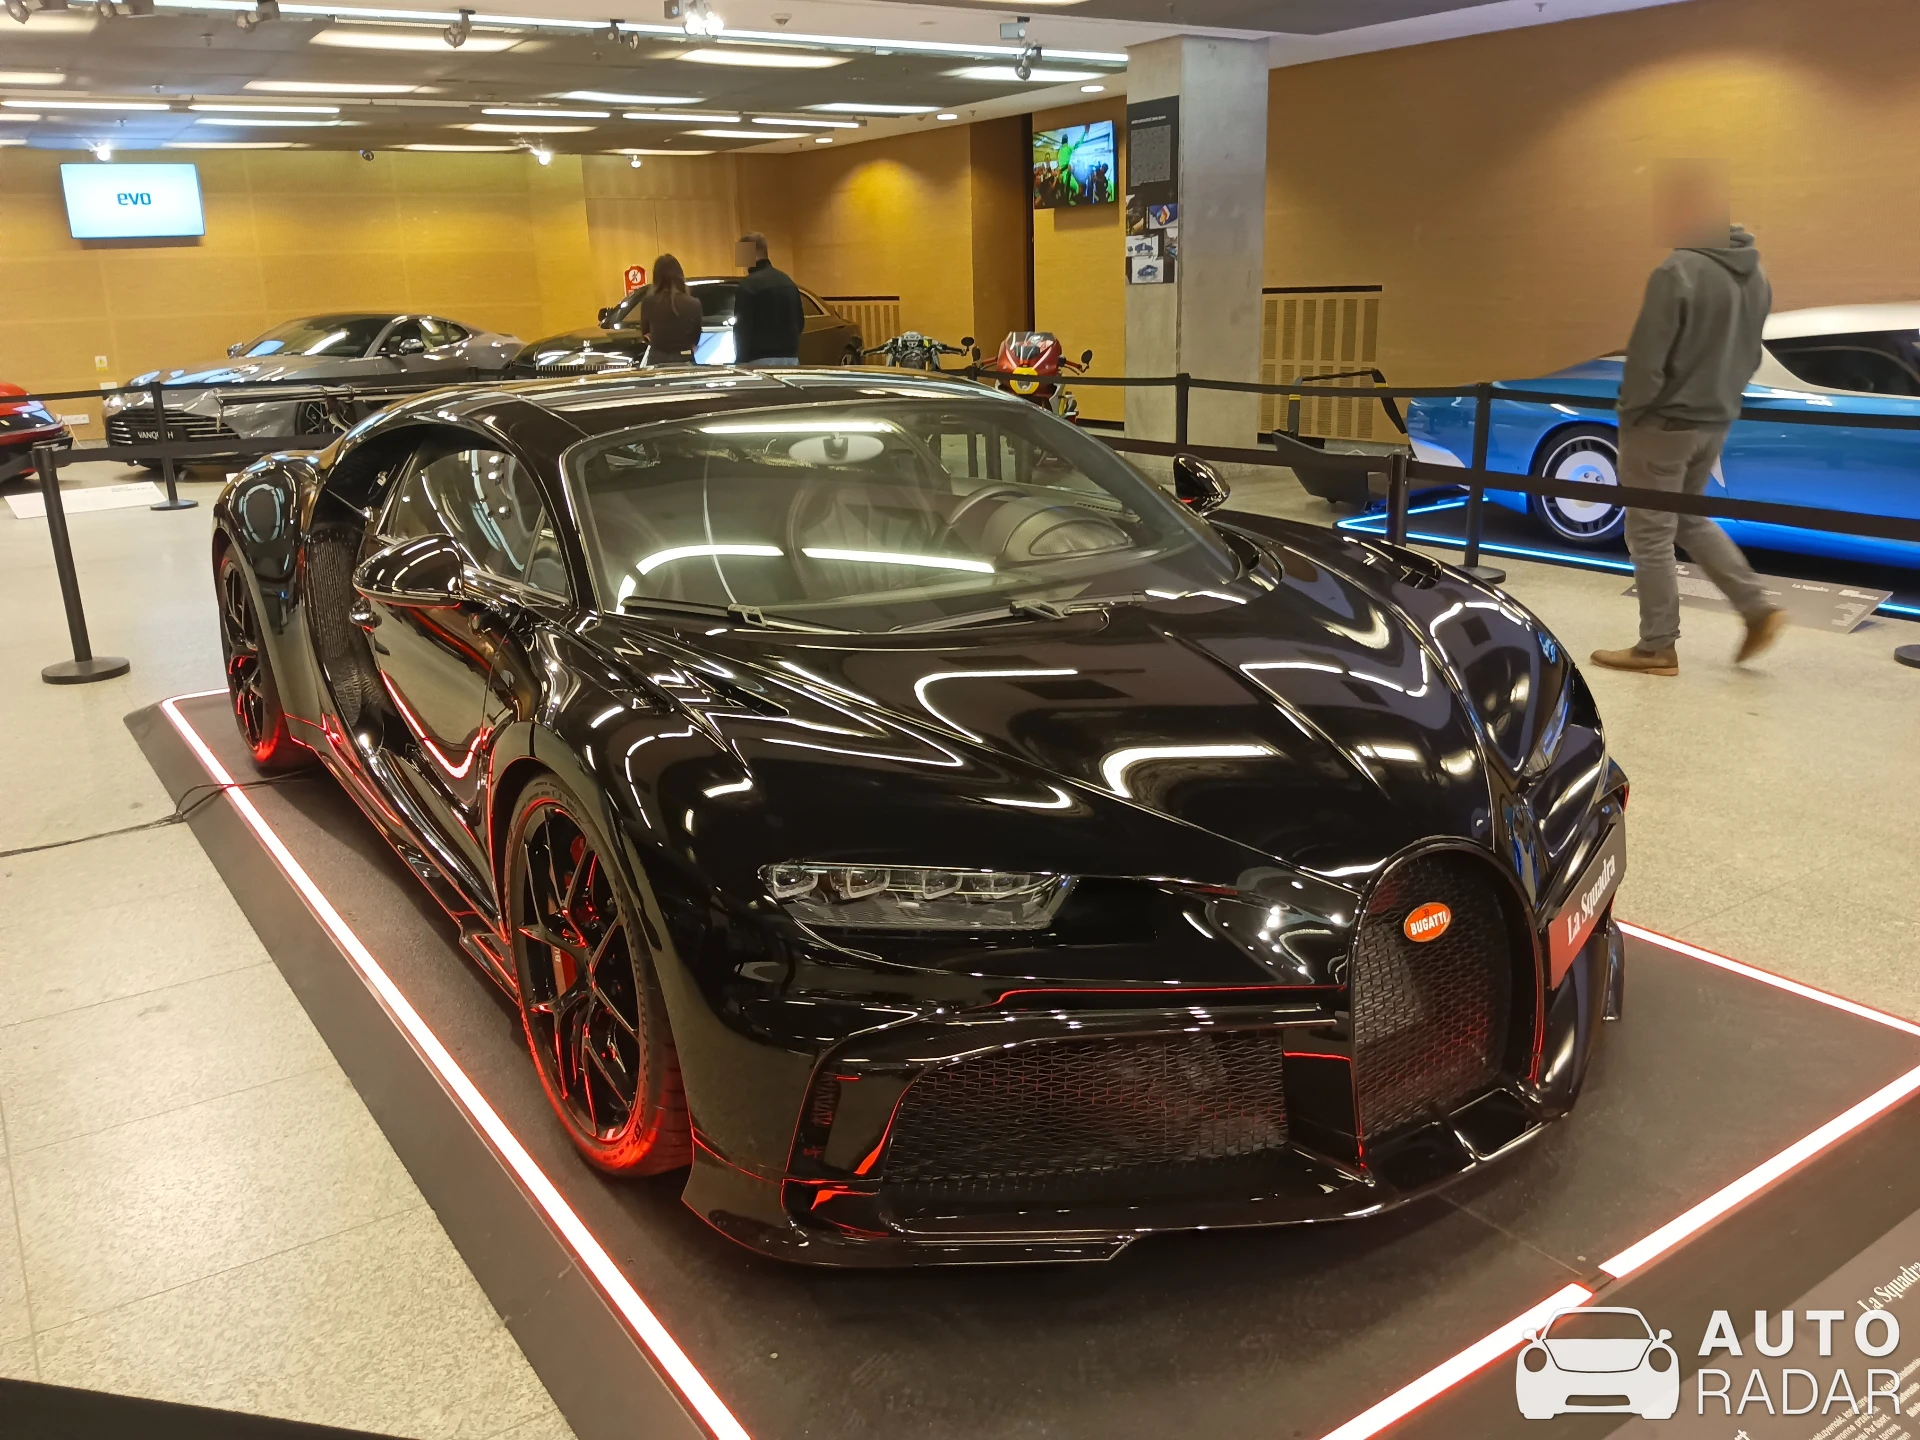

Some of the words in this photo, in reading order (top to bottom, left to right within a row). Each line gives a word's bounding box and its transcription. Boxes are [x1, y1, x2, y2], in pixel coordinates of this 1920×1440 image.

[117, 192, 152, 206] evo
[137, 431, 174, 441] VANQH
[1567, 911, 1581, 946] La
[1581, 854, 1616, 925] Squadra
[1410, 910, 1447, 936] BUGATTI
